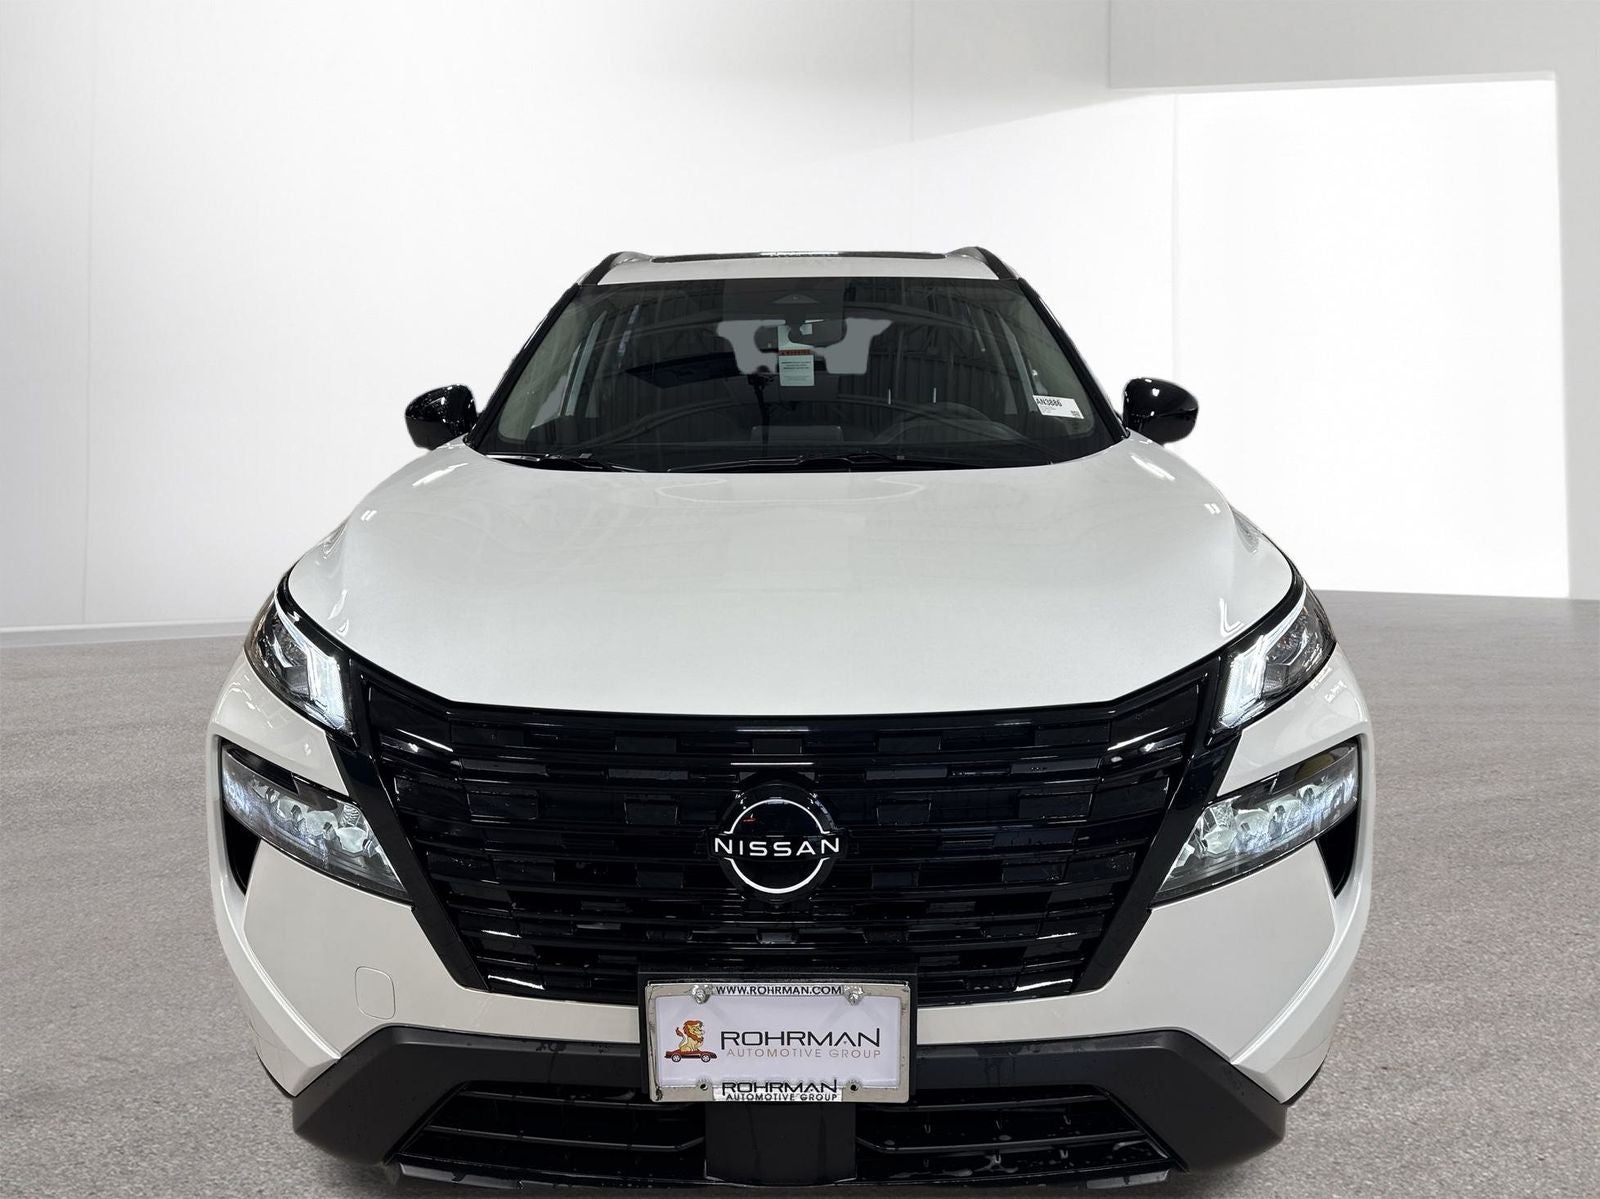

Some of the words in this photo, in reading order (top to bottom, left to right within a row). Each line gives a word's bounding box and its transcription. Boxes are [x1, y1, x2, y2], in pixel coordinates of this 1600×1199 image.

[714, 837, 840, 856] NISSAN
[715, 985, 842, 995] WWW.ROHRMAN.COM
[720, 1028, 880, 1050] ROHRMAN
[726, 1048, 821, 1058] AUTOMOTIVE
[828, 1049, 881, 1059] GROUP
[722, 1079, 837, 1096] ROHRMAN
[726, 1093, 797, 1101] AUTOMOTIVE
[799, 1093, 838, 1101] GROUP
